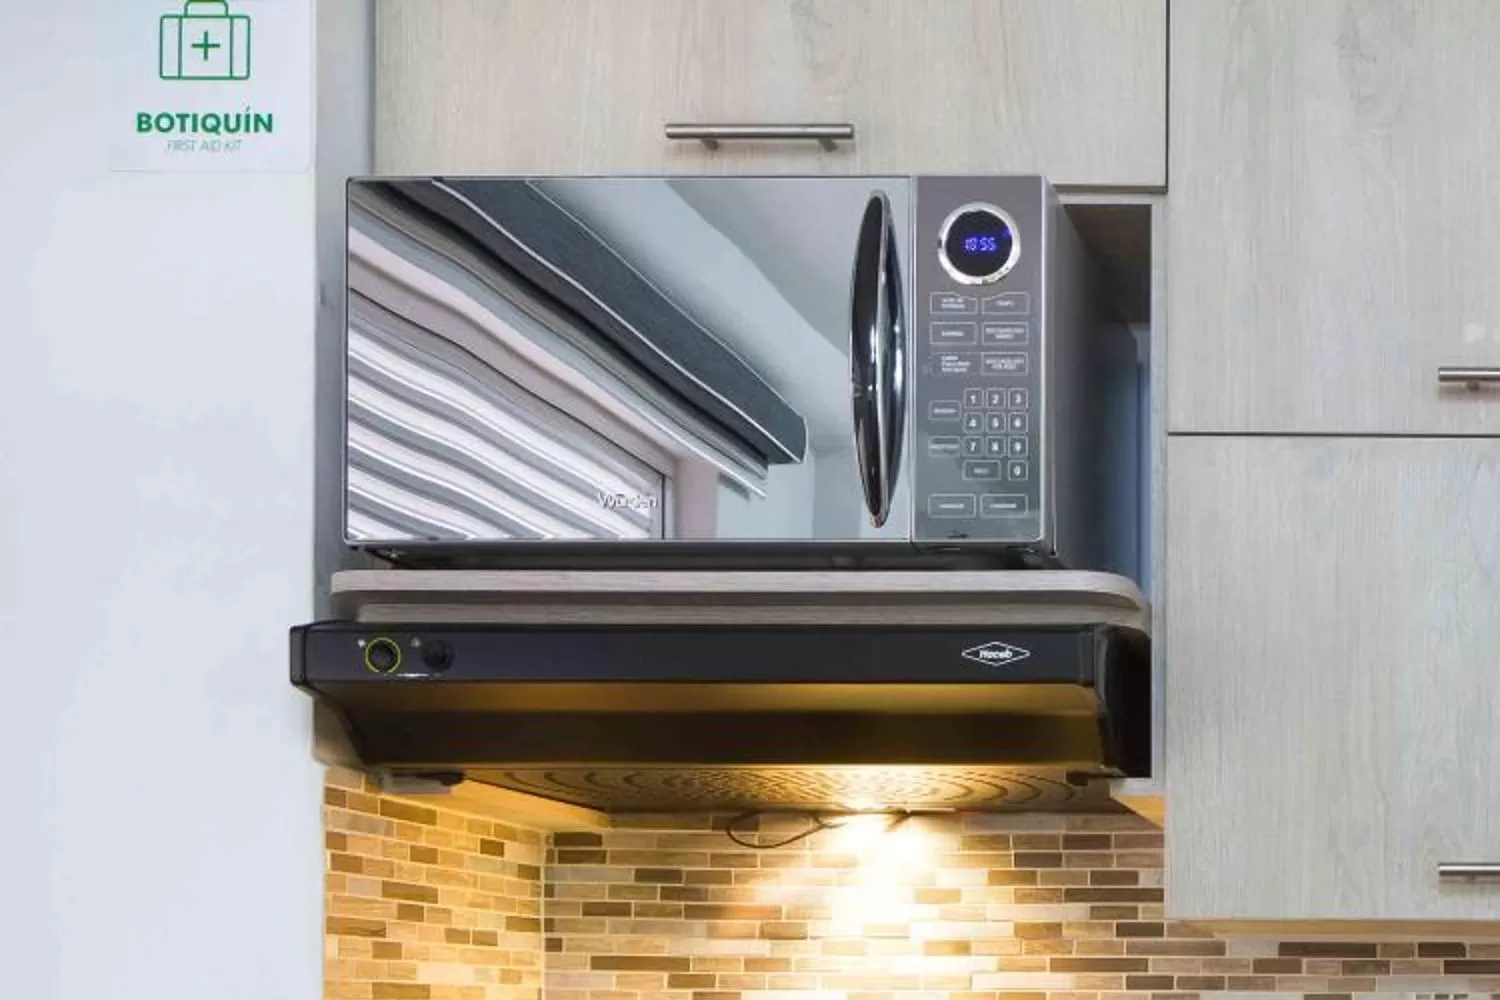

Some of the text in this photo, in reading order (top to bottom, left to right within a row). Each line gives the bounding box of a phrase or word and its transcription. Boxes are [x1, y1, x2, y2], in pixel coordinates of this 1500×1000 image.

[136, 105, 273, 135] BOTIQUÍN
[168, 139, 243, 152] FIRST AID KIT
